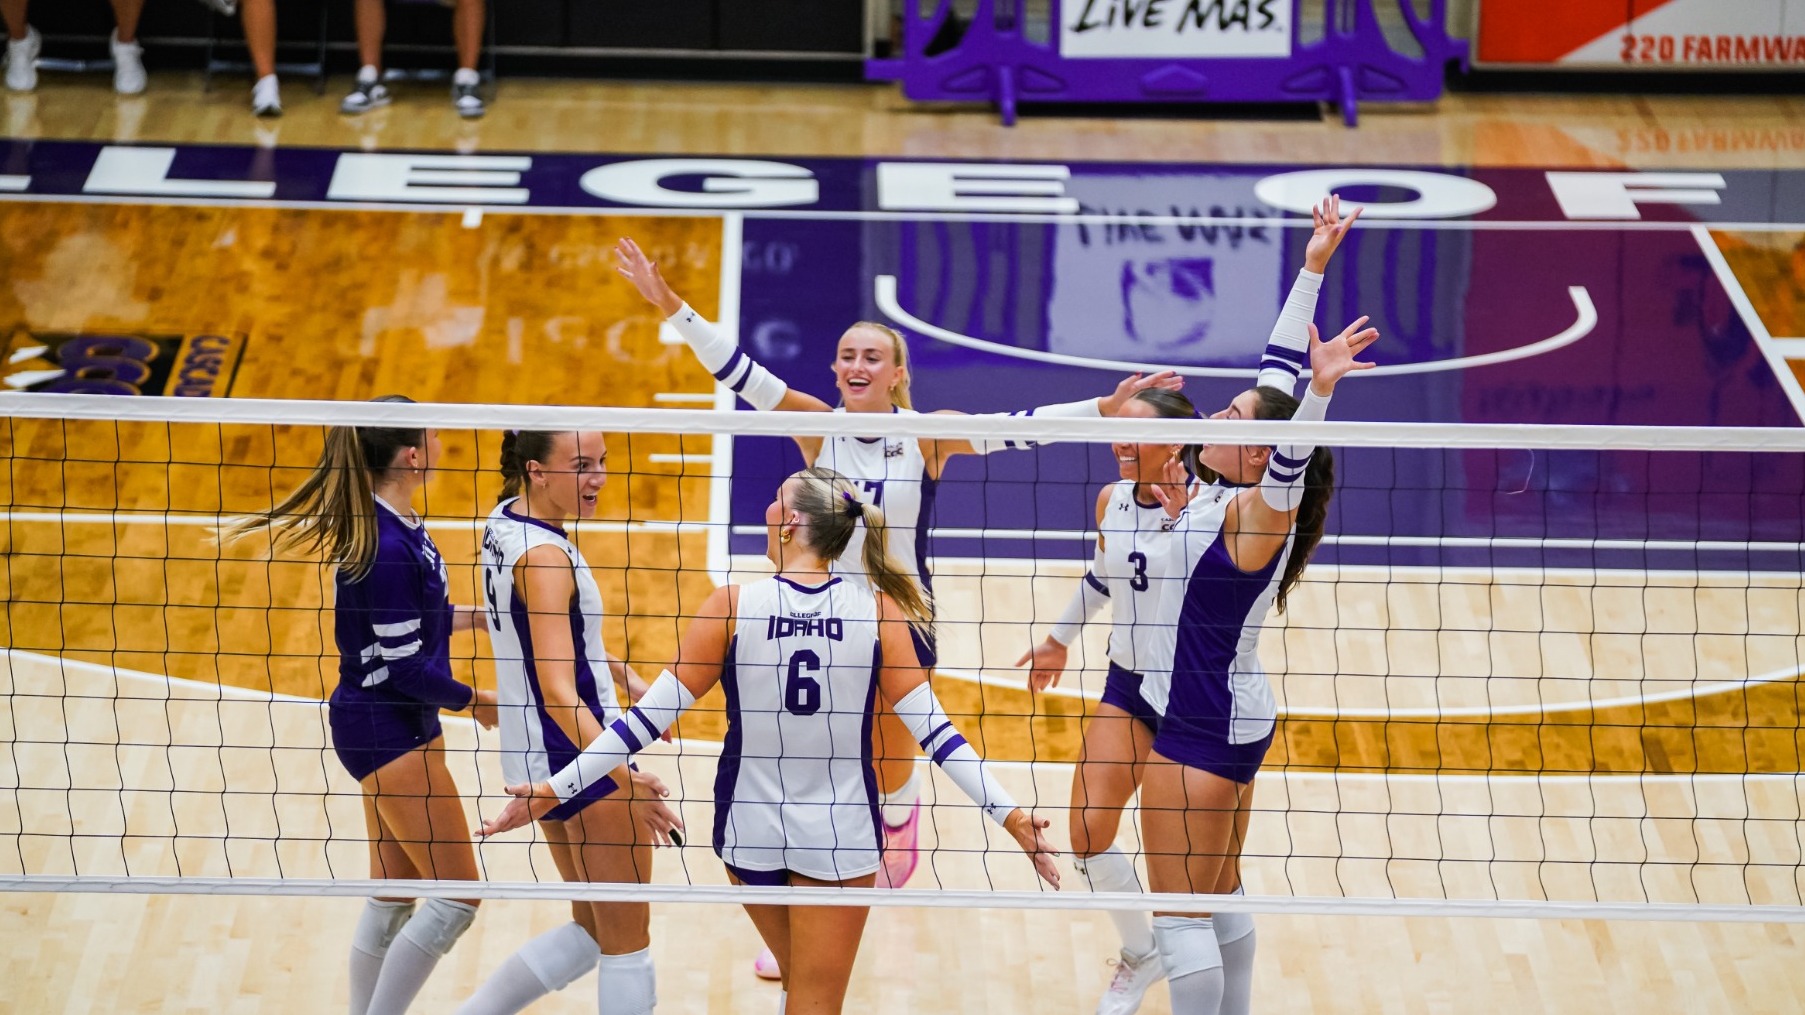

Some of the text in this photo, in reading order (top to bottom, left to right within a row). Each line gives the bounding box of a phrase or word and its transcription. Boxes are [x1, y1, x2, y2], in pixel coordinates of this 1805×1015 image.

[1620, 35, 1675, 62] 220
[0, 146, 1728, 220] LEGE OF
[853, 481, 884, 505] 7
[1128, 551, 1149, 592] 3
[485, 567, 501, 632] 9
[767, 615, 843, 642] IDAHO
[785, 649, 821, 716] 6
